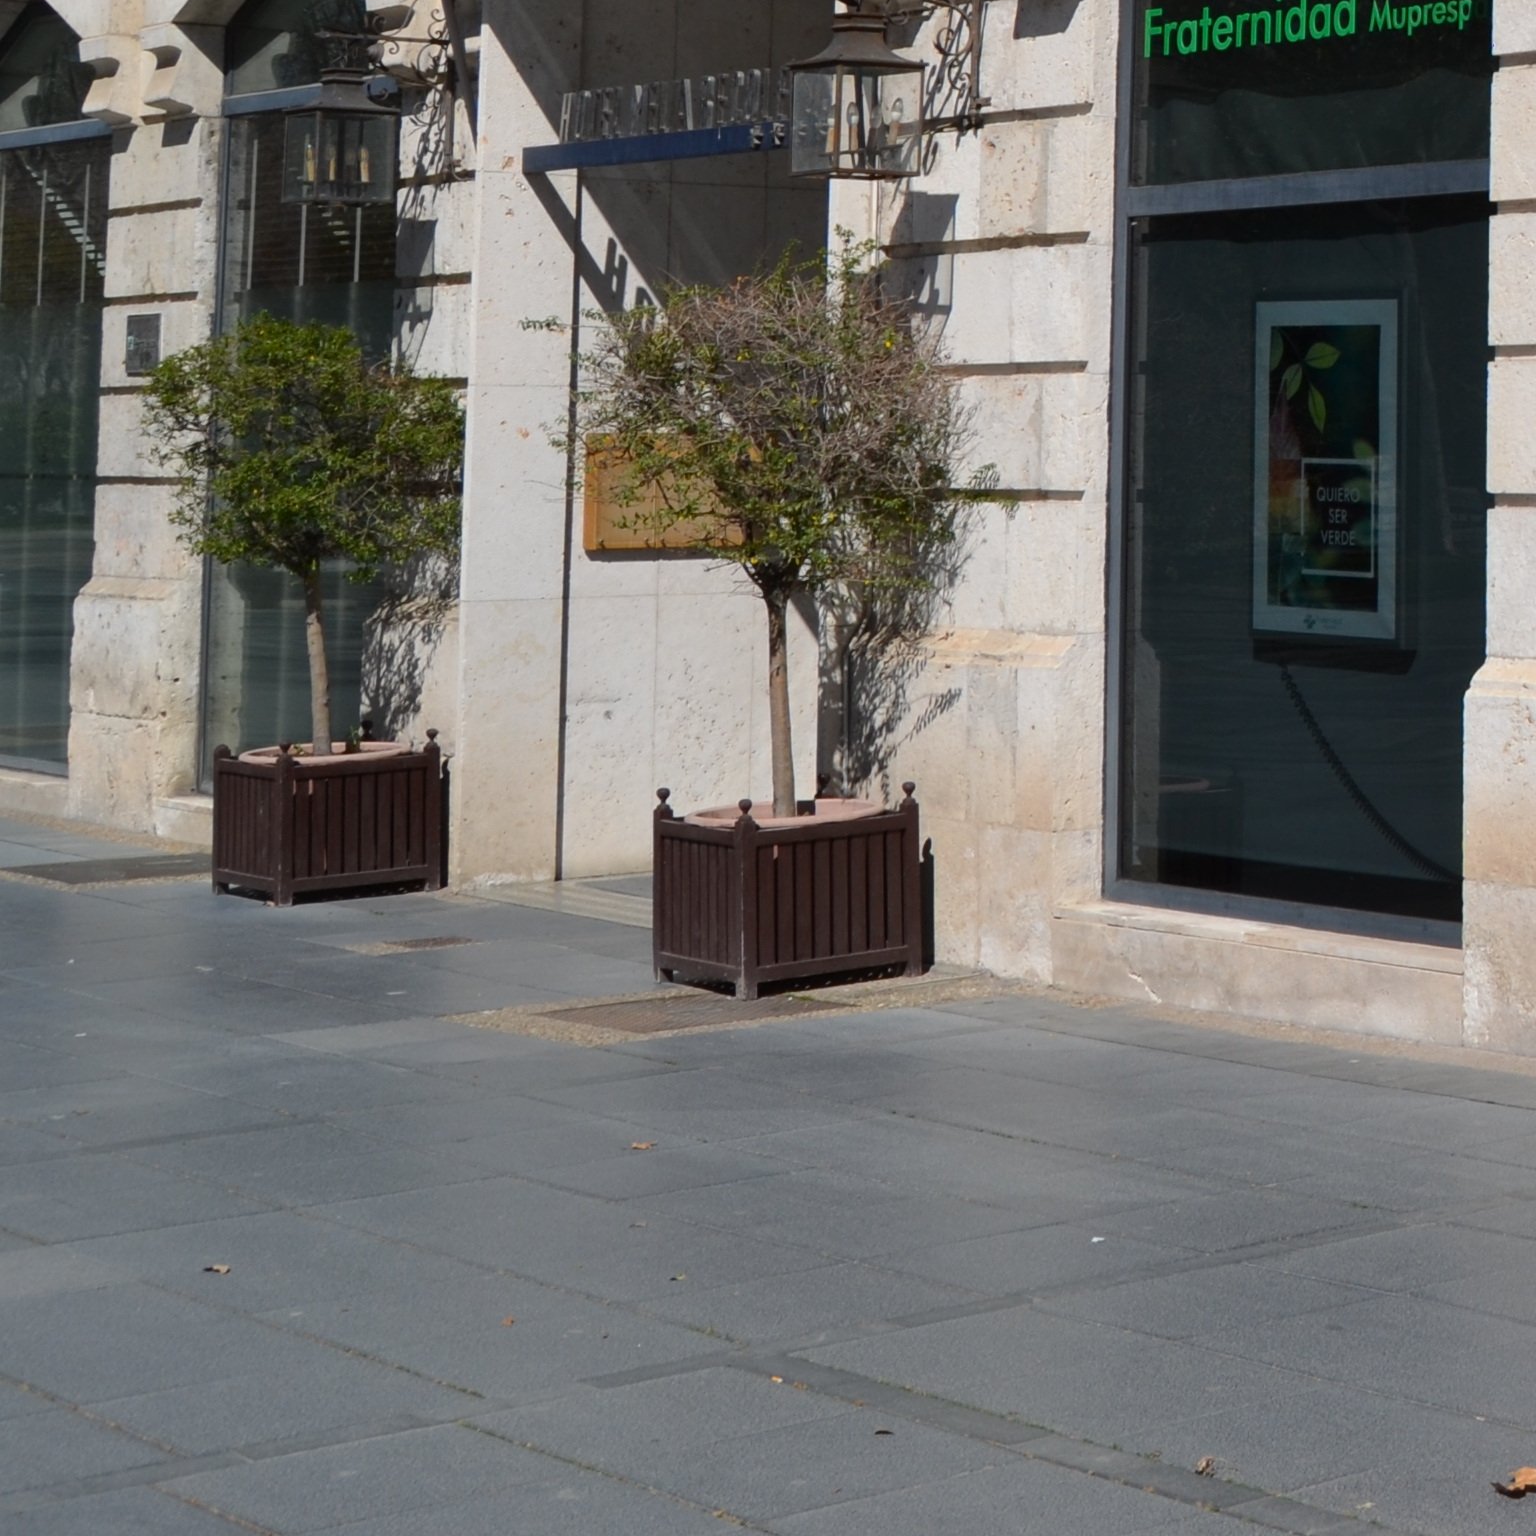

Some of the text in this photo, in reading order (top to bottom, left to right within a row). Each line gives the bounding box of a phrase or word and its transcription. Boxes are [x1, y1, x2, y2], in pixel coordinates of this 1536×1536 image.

[1316, 486, 1361, 504] QUIERO
[1328, 508, 1348, 525] SER
[1320, 529, 1356, 547] VERDE
